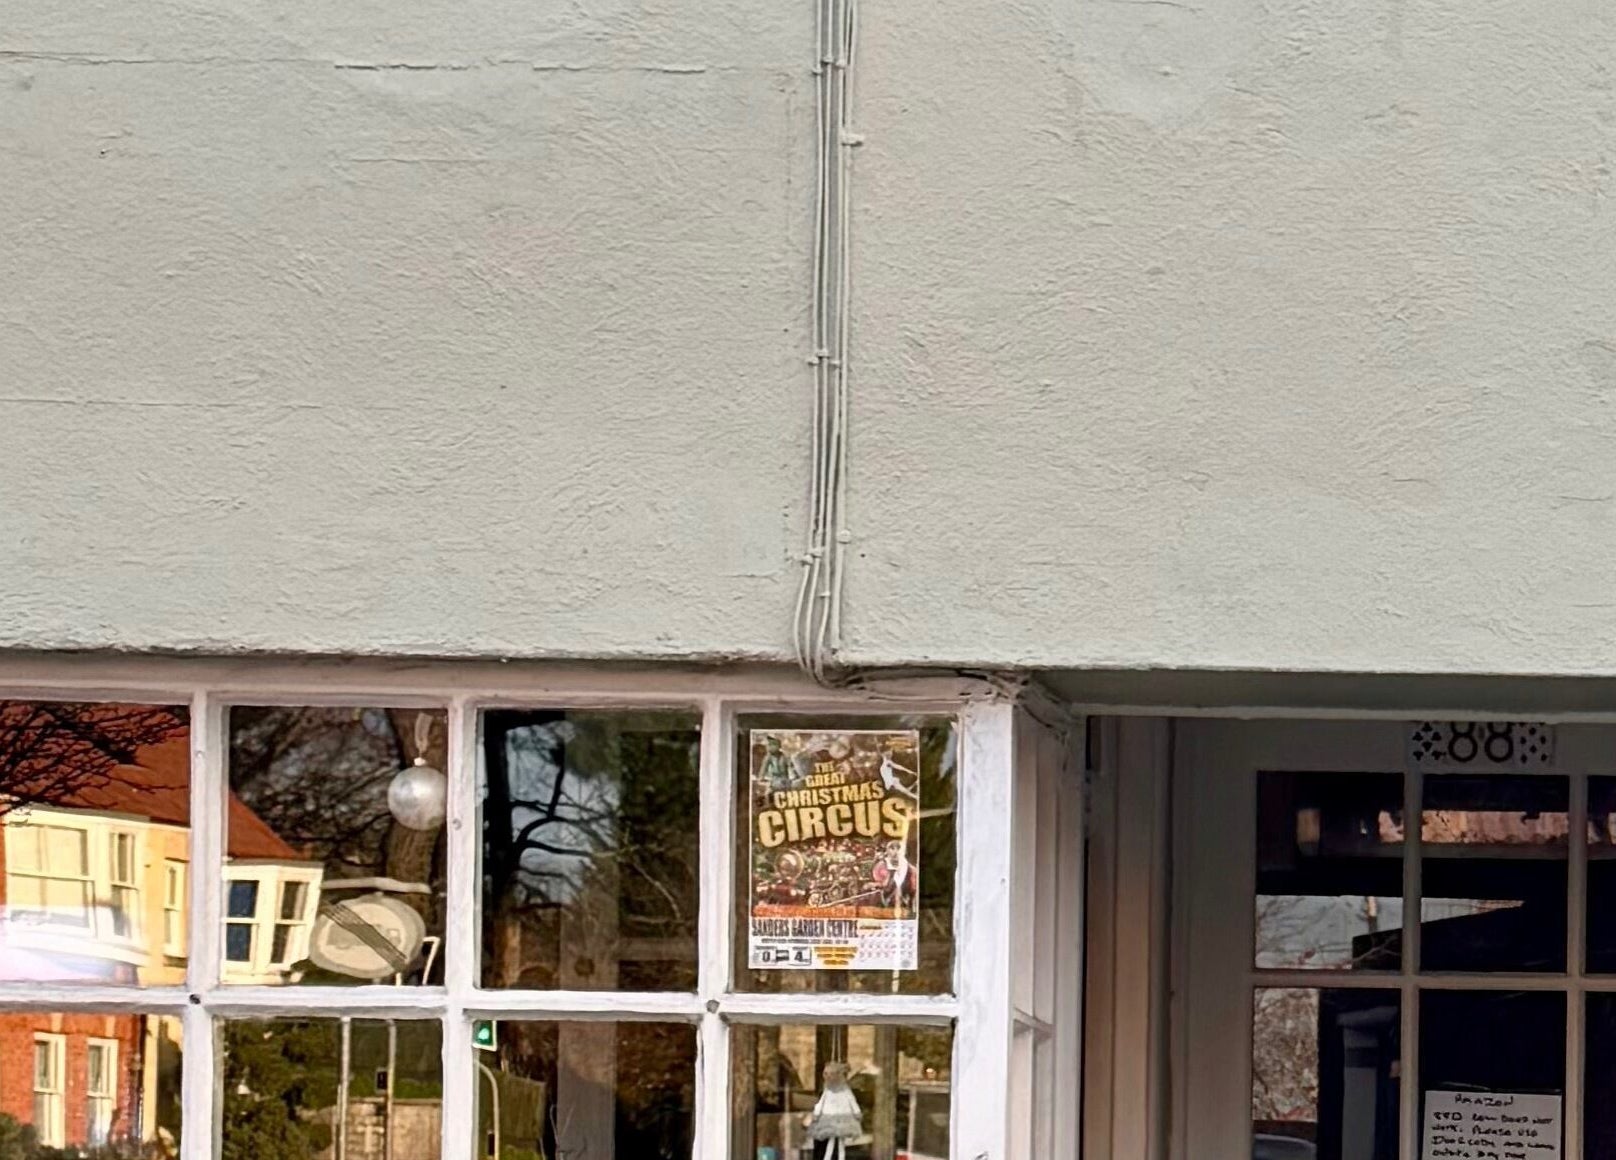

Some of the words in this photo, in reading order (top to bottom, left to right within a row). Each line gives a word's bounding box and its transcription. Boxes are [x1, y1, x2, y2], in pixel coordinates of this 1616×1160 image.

[1448, 721, 1514, 763] 88
[774, 781, 884, 809] CHRISTMAS
[758, 797, 908, 848] CIRCUS
